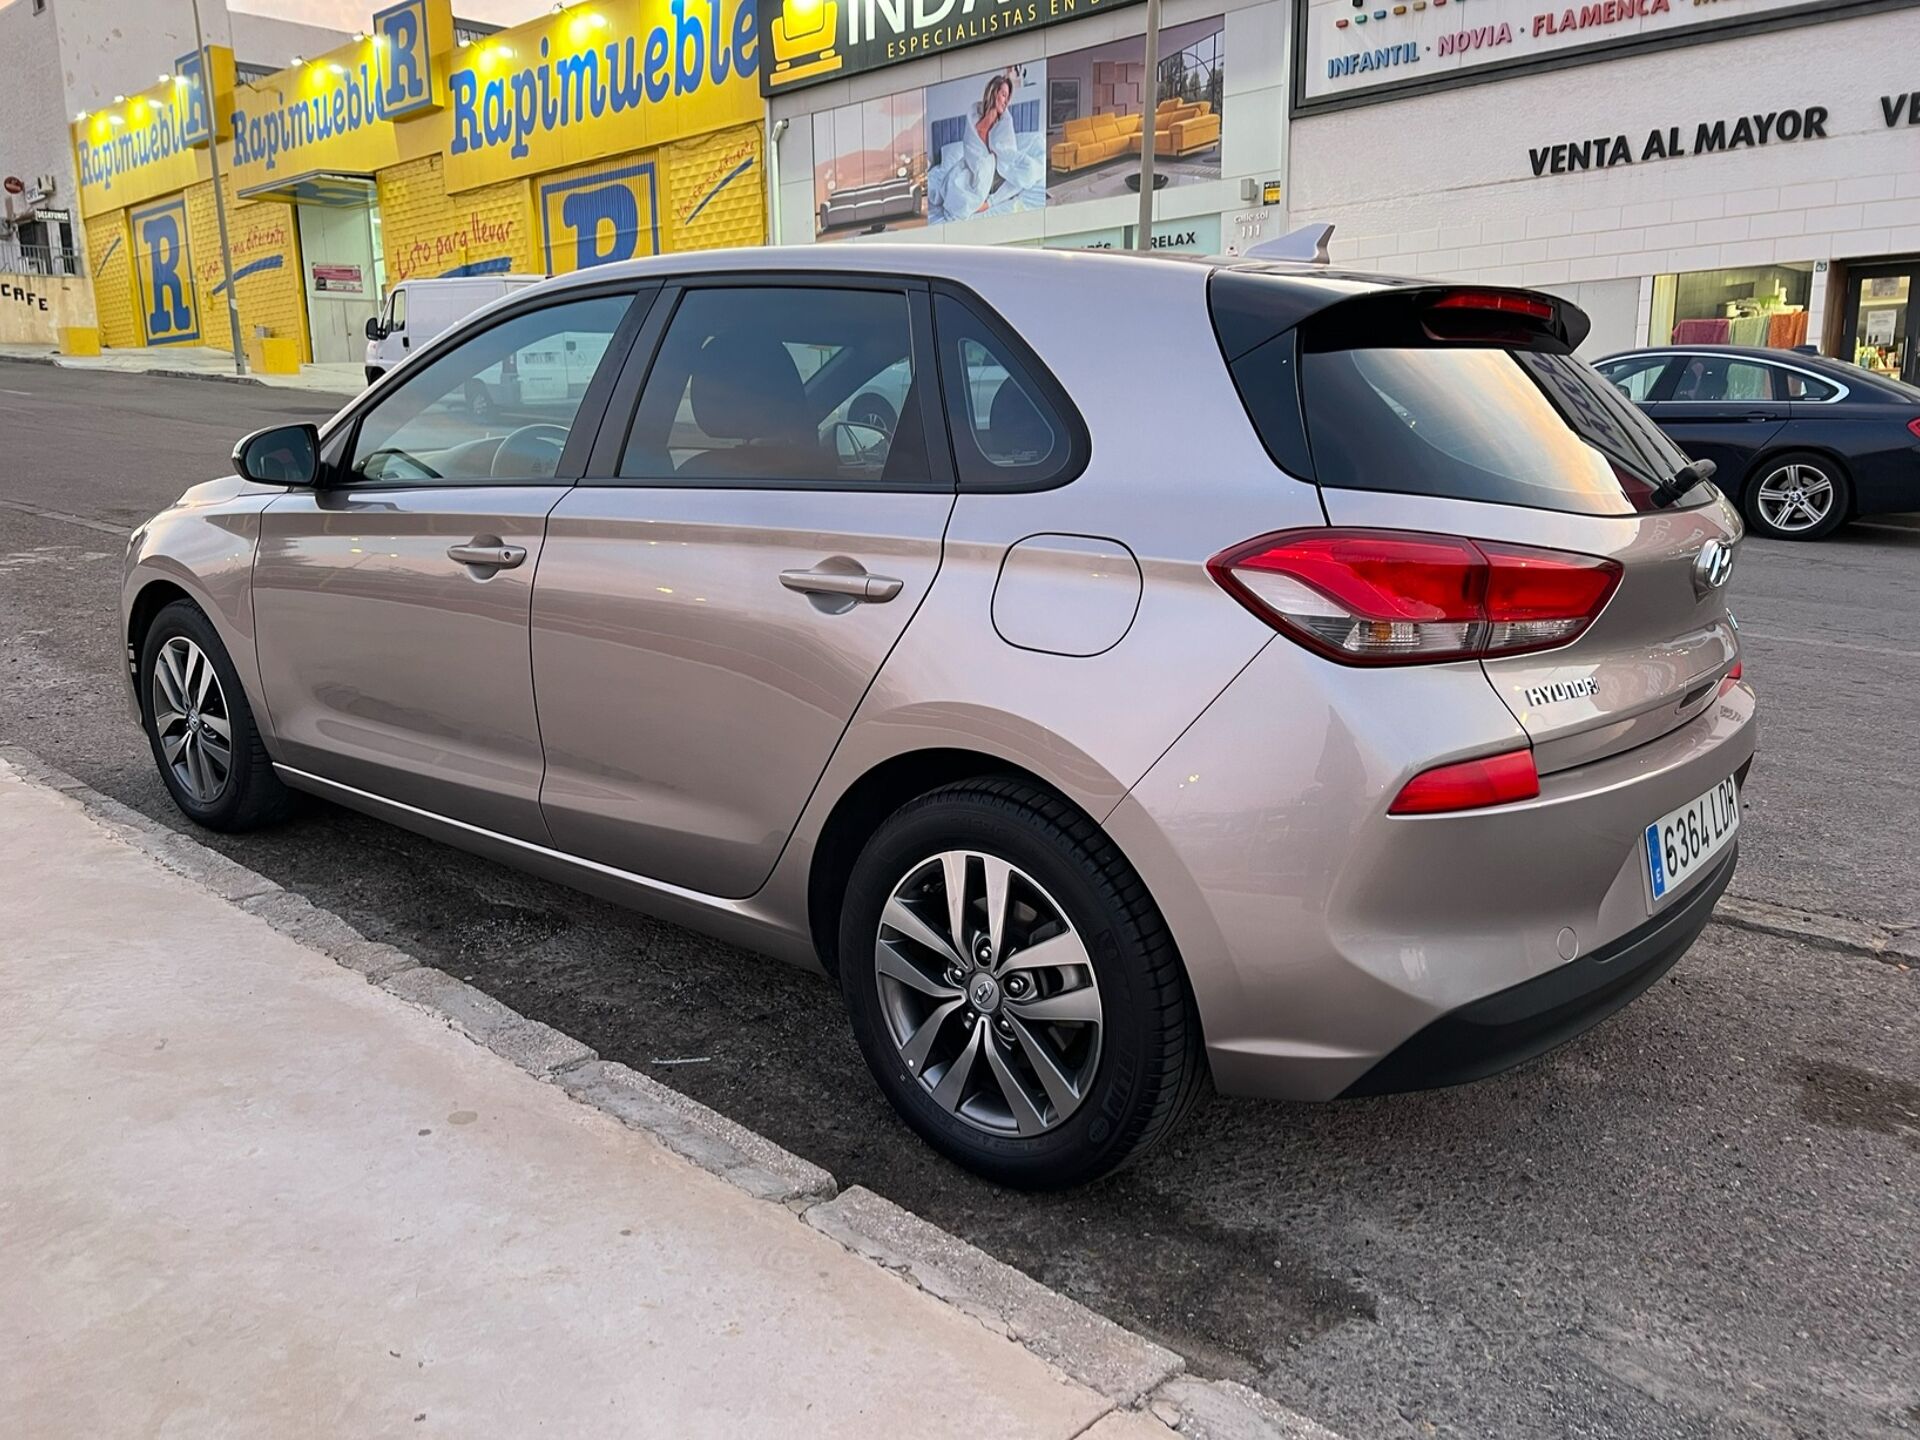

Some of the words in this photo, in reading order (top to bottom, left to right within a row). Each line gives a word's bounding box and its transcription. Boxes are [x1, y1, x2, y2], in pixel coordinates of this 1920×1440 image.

[382, 9, 423, 106] R
[887, 4, 1036, 58] ESPECIALISTAS
[1328, 42, 1420, 78] INFANTIL
[1438, 22, 1512, 57] NOVIA
[1532, 0, 1670, 37] FLAMENCA
[1529, 135, 1632, 177] VENTA
[1641, 127, 1685, 161] AL
[1694, 106, 1829, 156] MAYOR
[395, 236, 432, 279] Listo
[437, 230, 468, 266] para
[471, 211, 514, 243] llevar
[1151, 231, 1196, 249] RELAX
[1241, 223, 1261, 238] 111
[1, 283, 48, 311] CAFE
[143, 214, 191, 334] R
[1664, 807, 1709, 878] 6364
[1710, 776, 1737, 840] LDR
